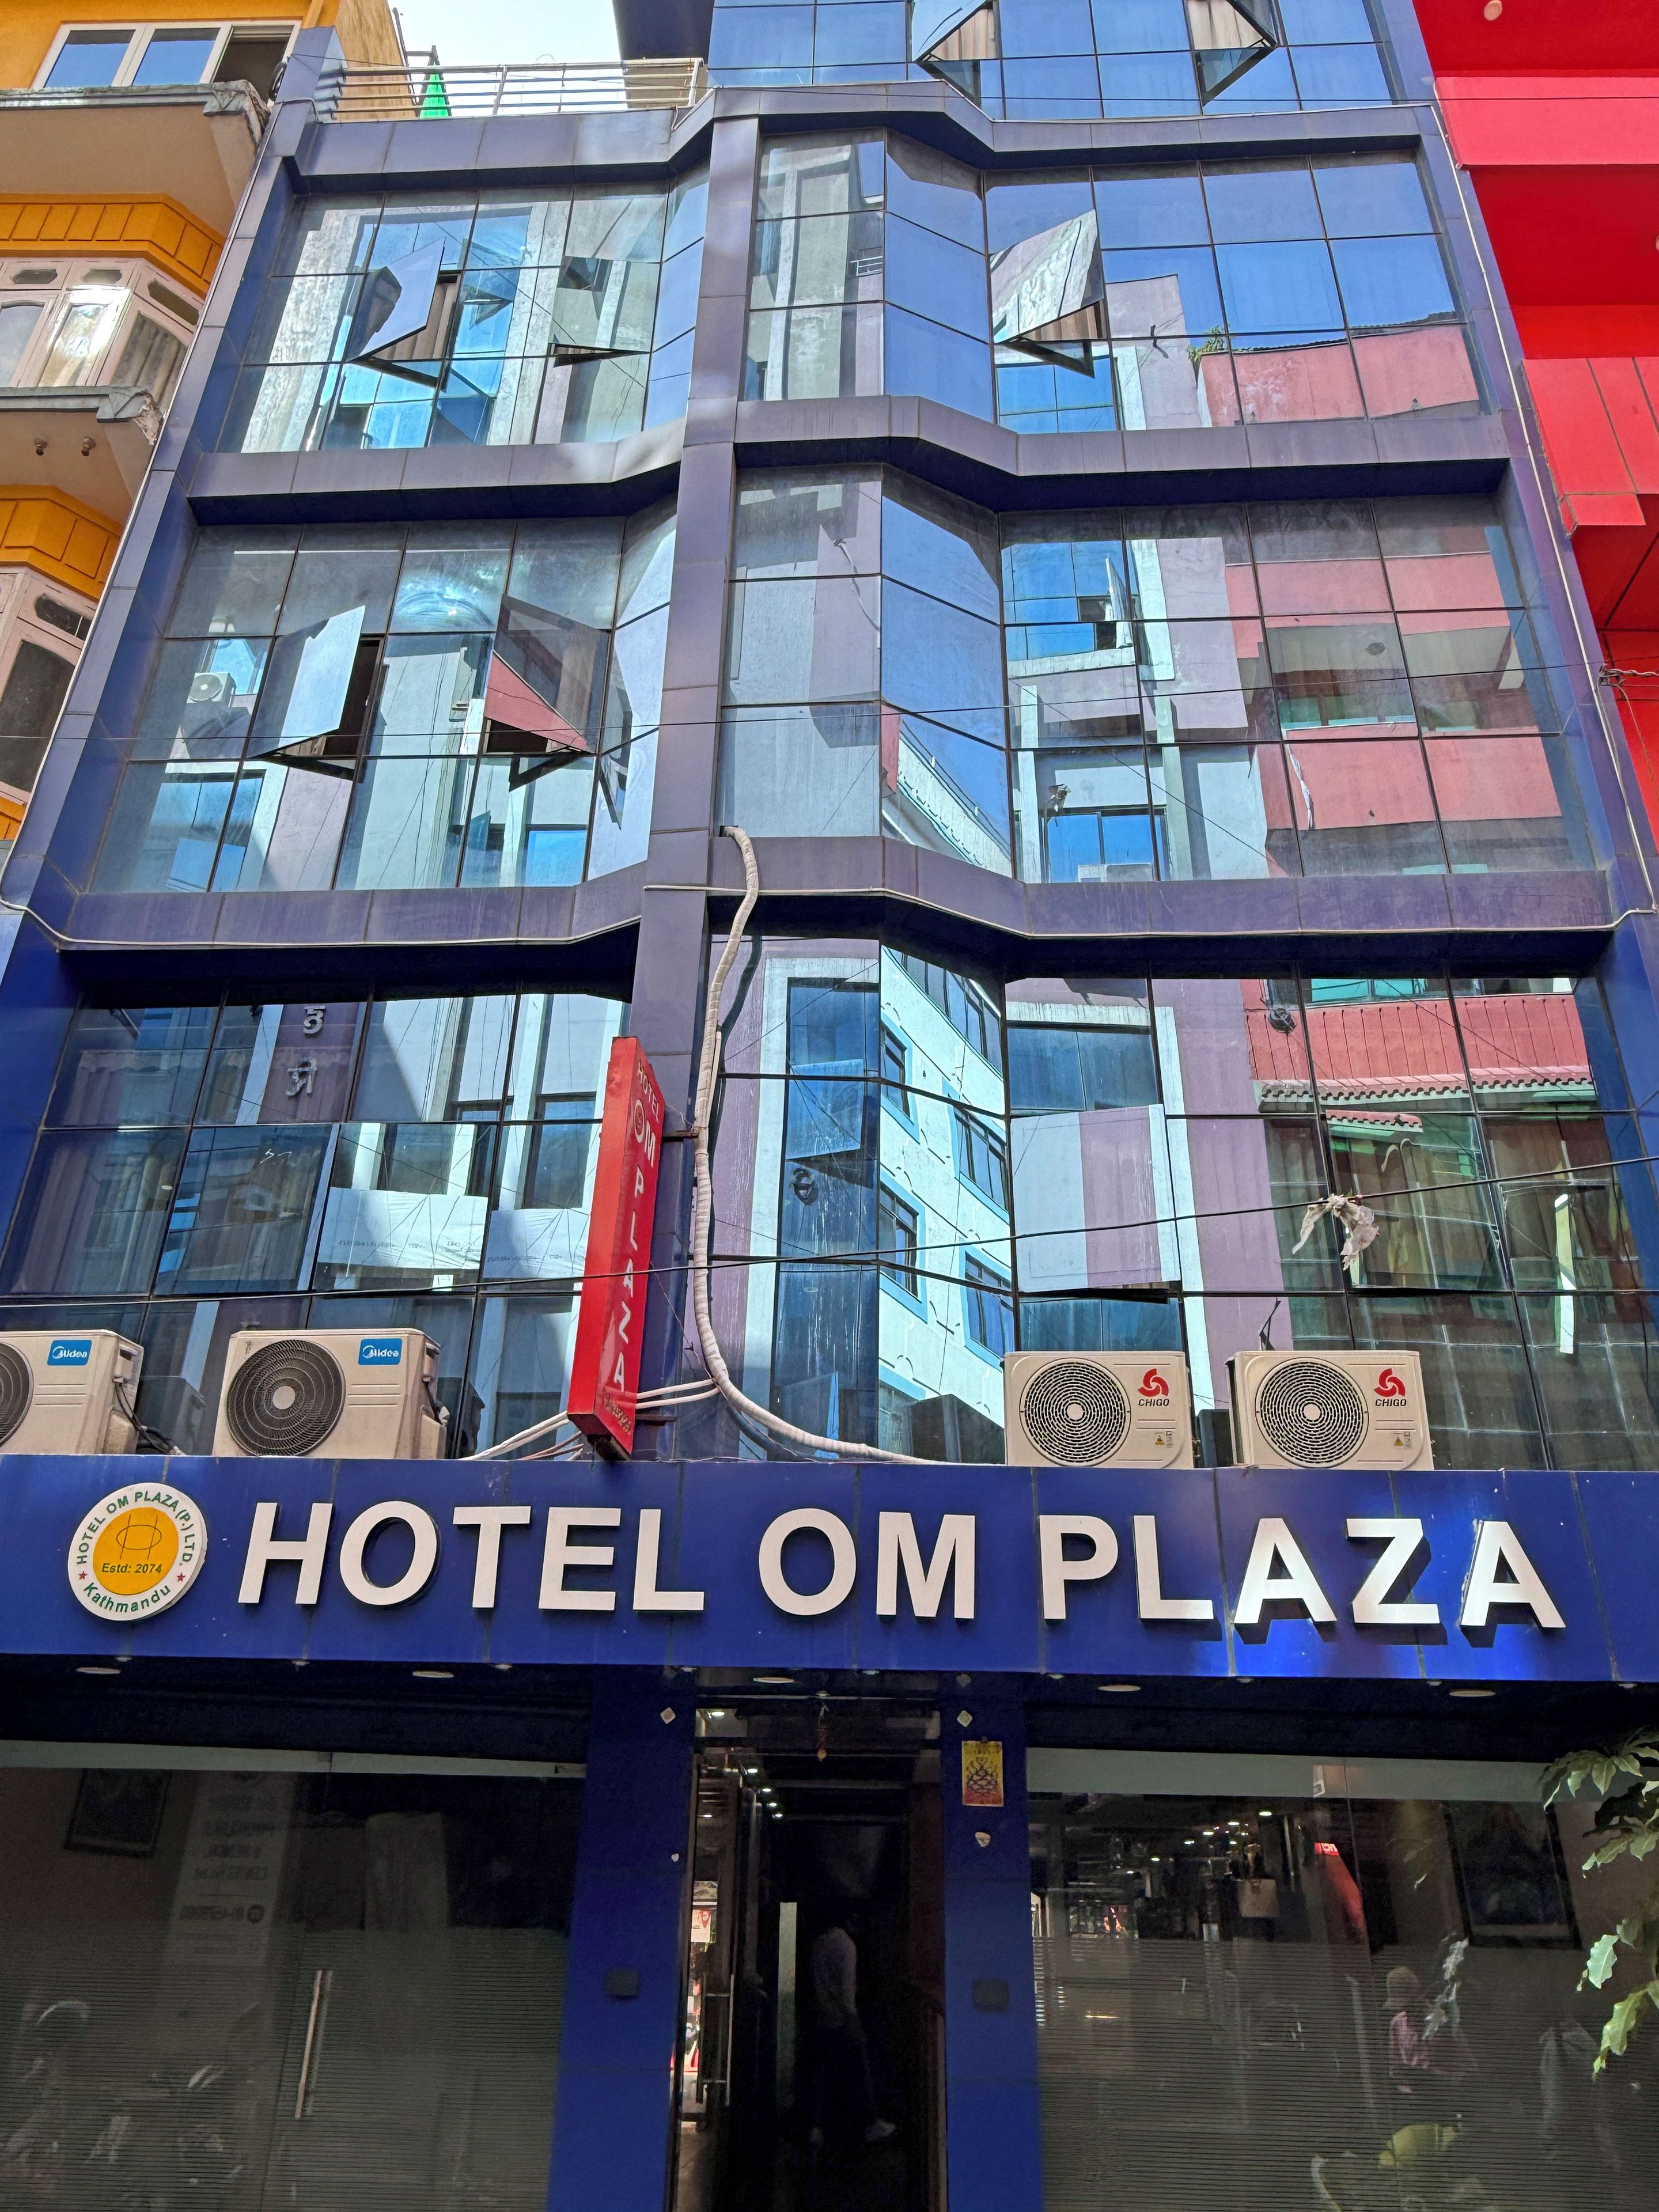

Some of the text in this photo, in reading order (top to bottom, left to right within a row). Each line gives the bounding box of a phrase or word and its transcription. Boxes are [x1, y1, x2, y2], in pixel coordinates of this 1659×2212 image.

[638, 1059, 659, 1123] HOTEL
[634, 1099, 656, 1168] OM
[612, 1166, 646, 1393] PLAZA
[52, 1346, 88, 1359] Midea
[362, 1344, 399, 1359] Midea
[1138, 1398, 1170, 1407] CHIGO
[1375, 1398, 1407, 1407] CHIGO
[77, 1517, 106, 1565] HOTEL
[106, 1495, 129, 1514] OM
[134, 1563, 162, 1574] 2074
[238, 1501, 1566, 1628] HOTEL OM PLAZA
[83, 1582, 171, 1613] Kathmandu
